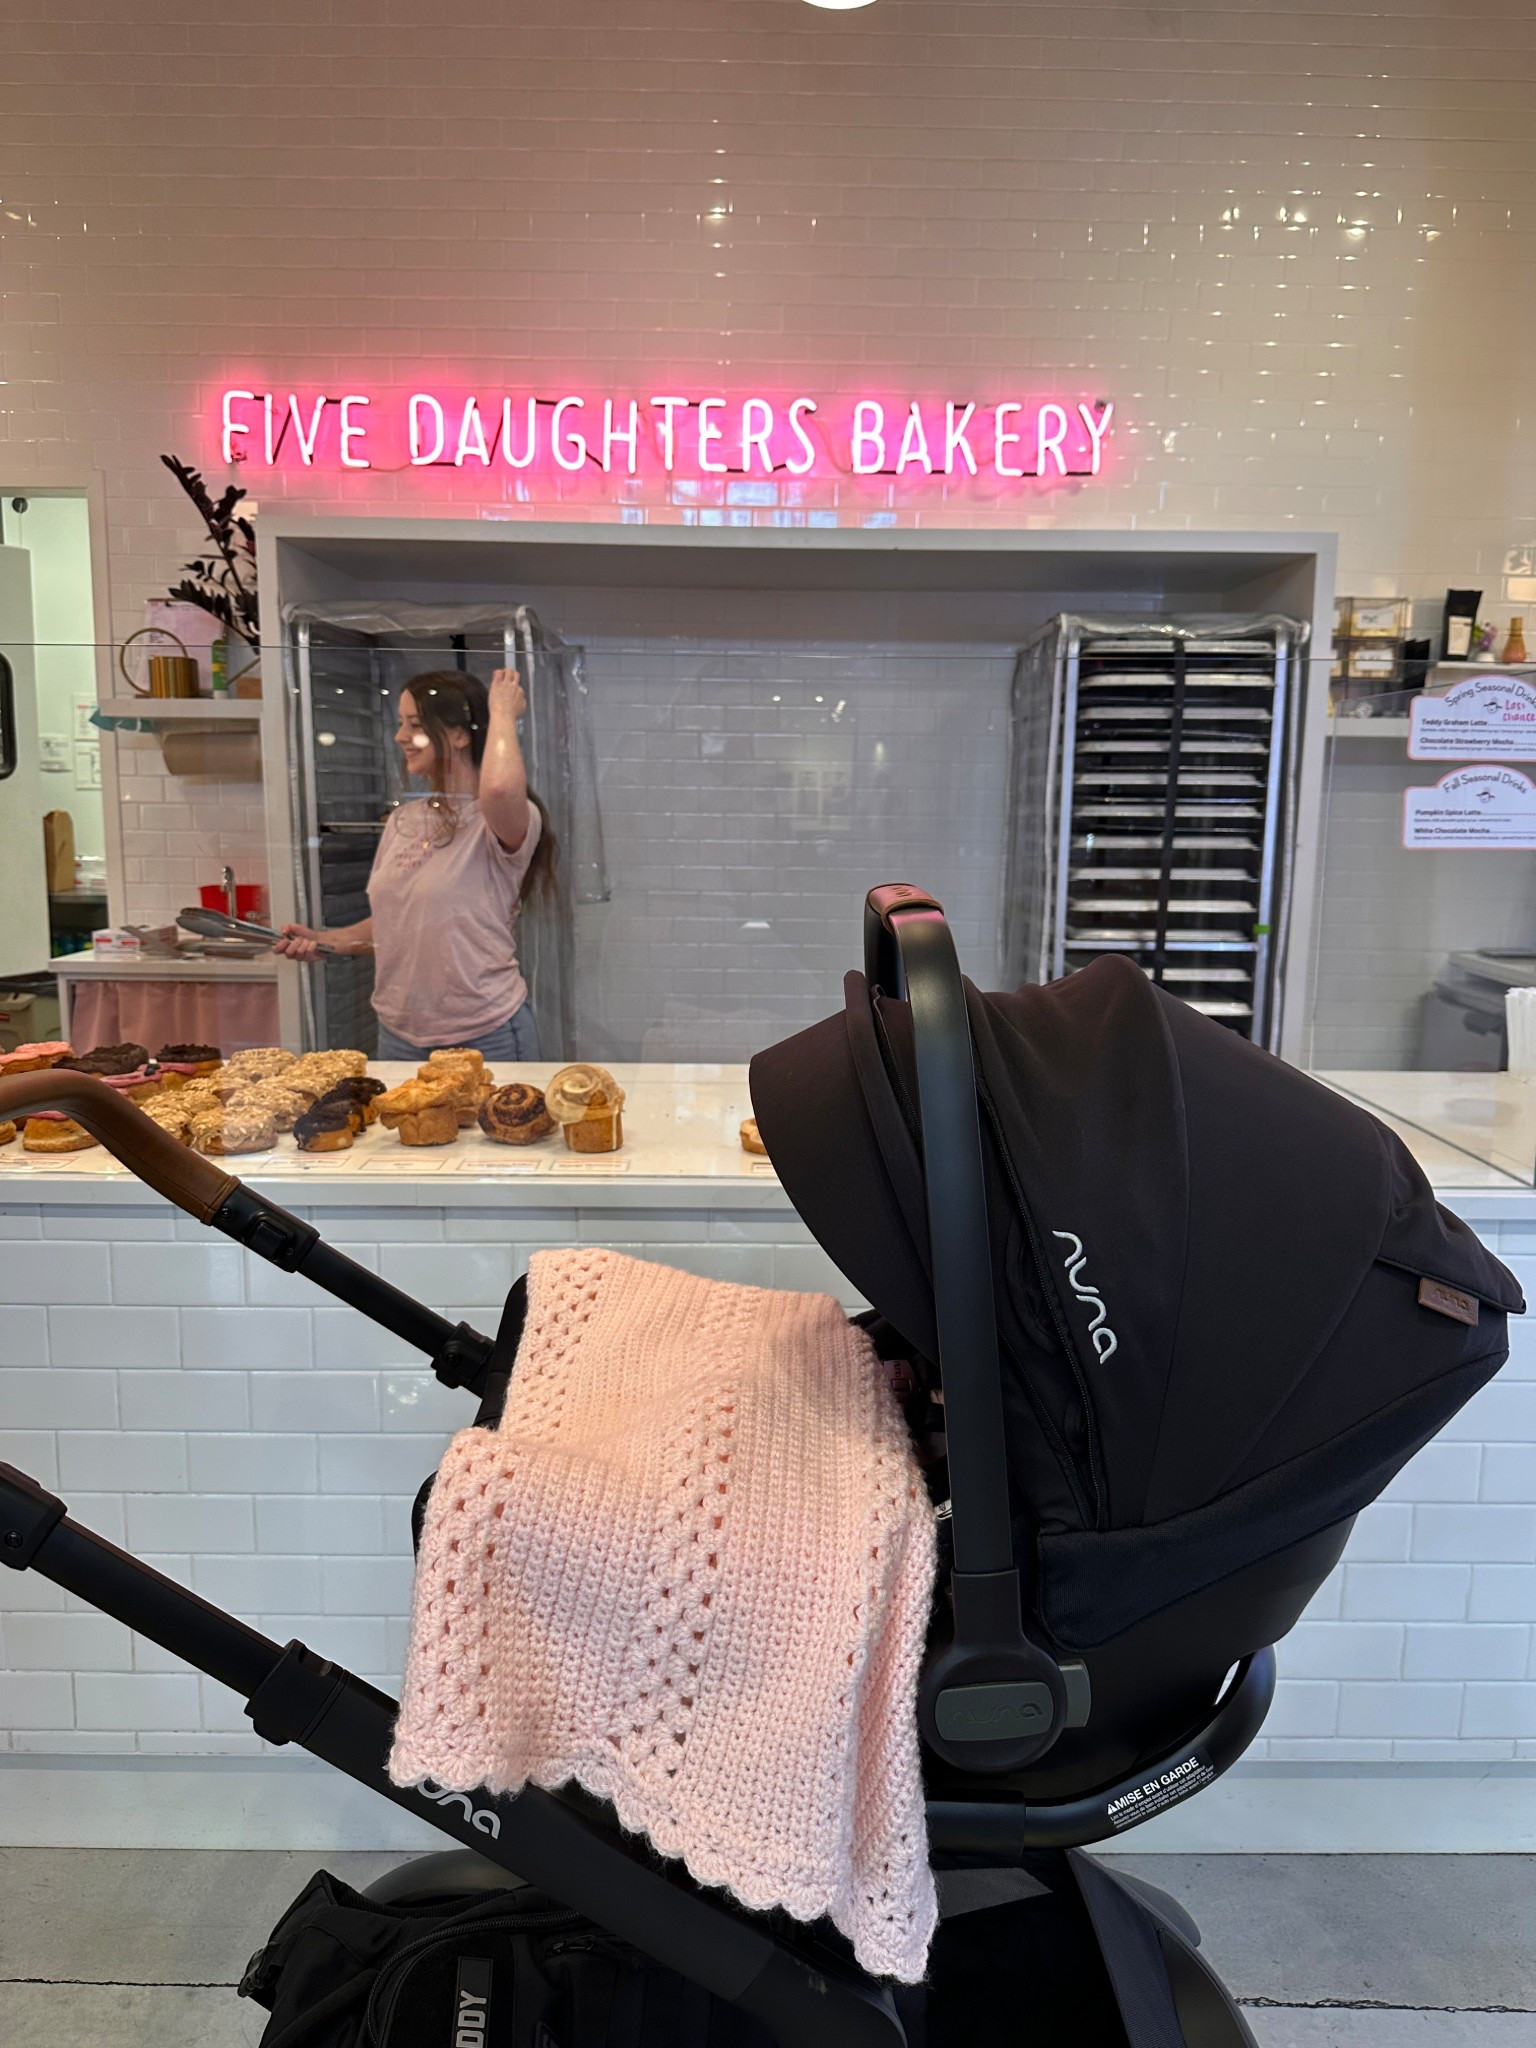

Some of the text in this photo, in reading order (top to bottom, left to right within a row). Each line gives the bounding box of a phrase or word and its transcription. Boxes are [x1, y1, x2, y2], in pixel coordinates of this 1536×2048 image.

[222, 391, 1115, 477] FIVE DAUGHTERS BAKERY
[1445, 689, 1475, 707] Spring
[1474, 682, 1516, 694] Seasonal
[1455, 738, 1491, 746] Strawberry
[1443, 772, 1527, 794] Fall Seasonal Drinks
[1052, 1230, 1118, 1365] nuna
[382, 1764, 500, 1839] una
[1113, 1787, 1143, 1810] MISE
[1142, 1779, 1160, 1795] EN
[1158, 1756, 1199, 1785] GARDE
